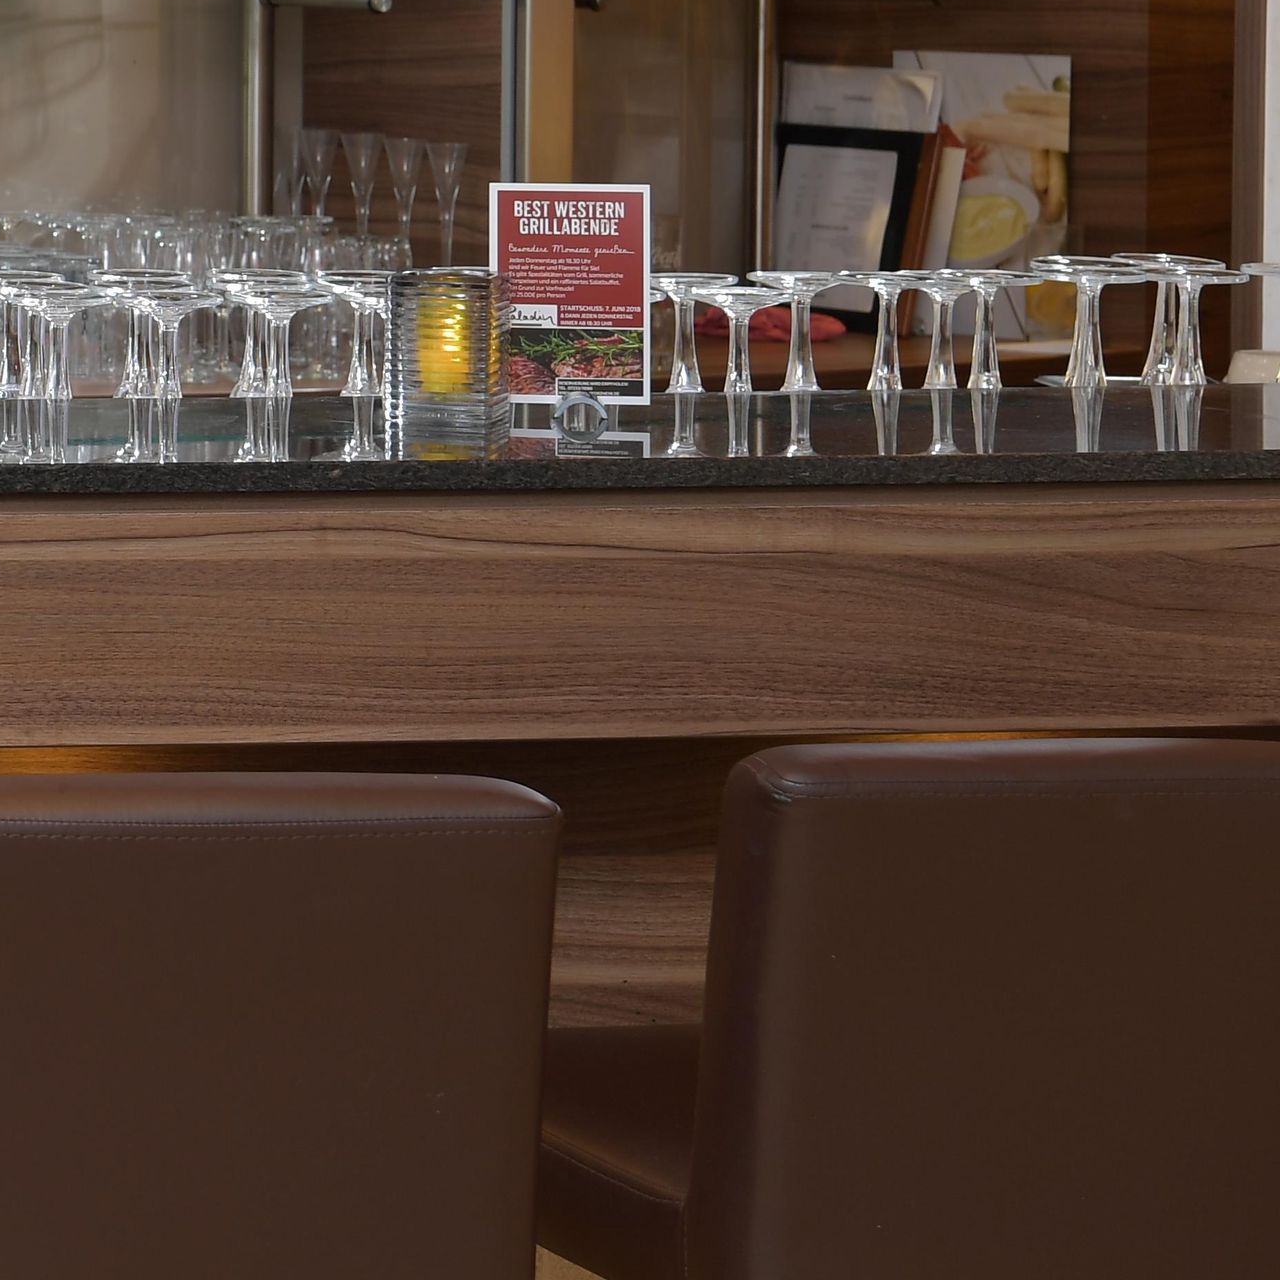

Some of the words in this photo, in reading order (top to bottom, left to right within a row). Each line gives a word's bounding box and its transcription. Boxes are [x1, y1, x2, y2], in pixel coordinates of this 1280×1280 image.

[513, 200, 550, 217] BEST
[555, 201, 625, 218] WESTERN
[520, 218, 619, 236] GRILLABENDE
[508, 242, 549, 253] Besondere
[552, 244, 591, 254] Momente
